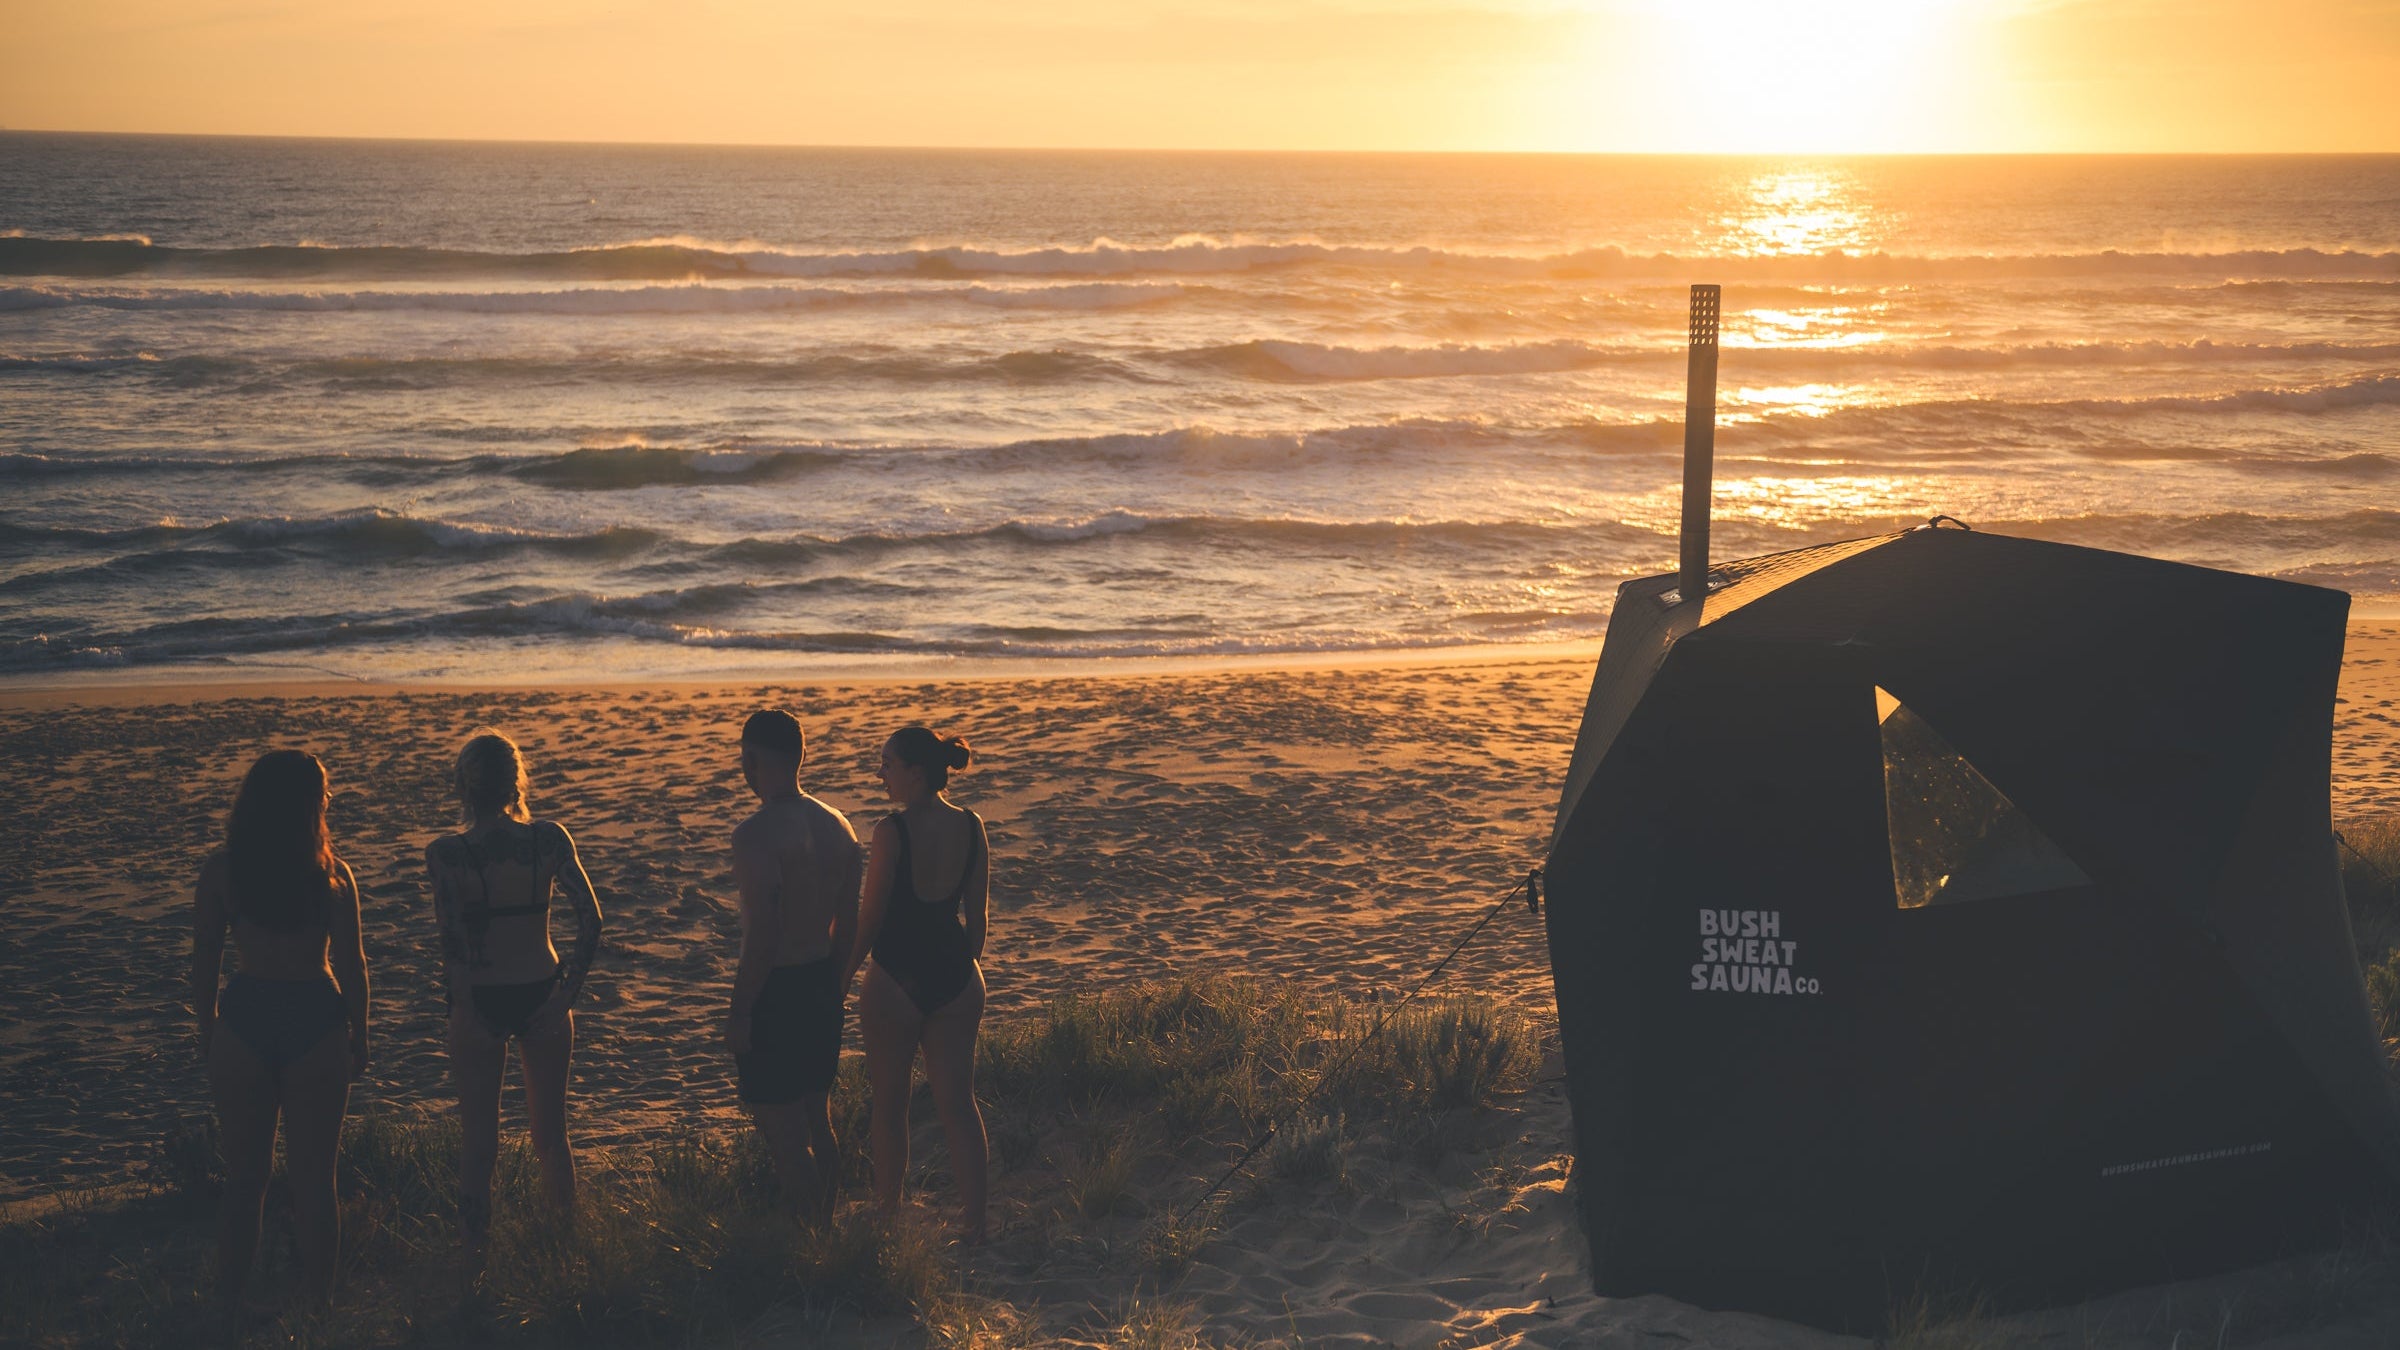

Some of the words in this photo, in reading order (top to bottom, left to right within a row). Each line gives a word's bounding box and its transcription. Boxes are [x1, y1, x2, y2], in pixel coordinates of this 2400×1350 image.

[1699, 908, 1780, 938] BUSH
[1702, 937, 1797, 966] SWEAT
[1690, 963, 1793, 995] SAUNA
